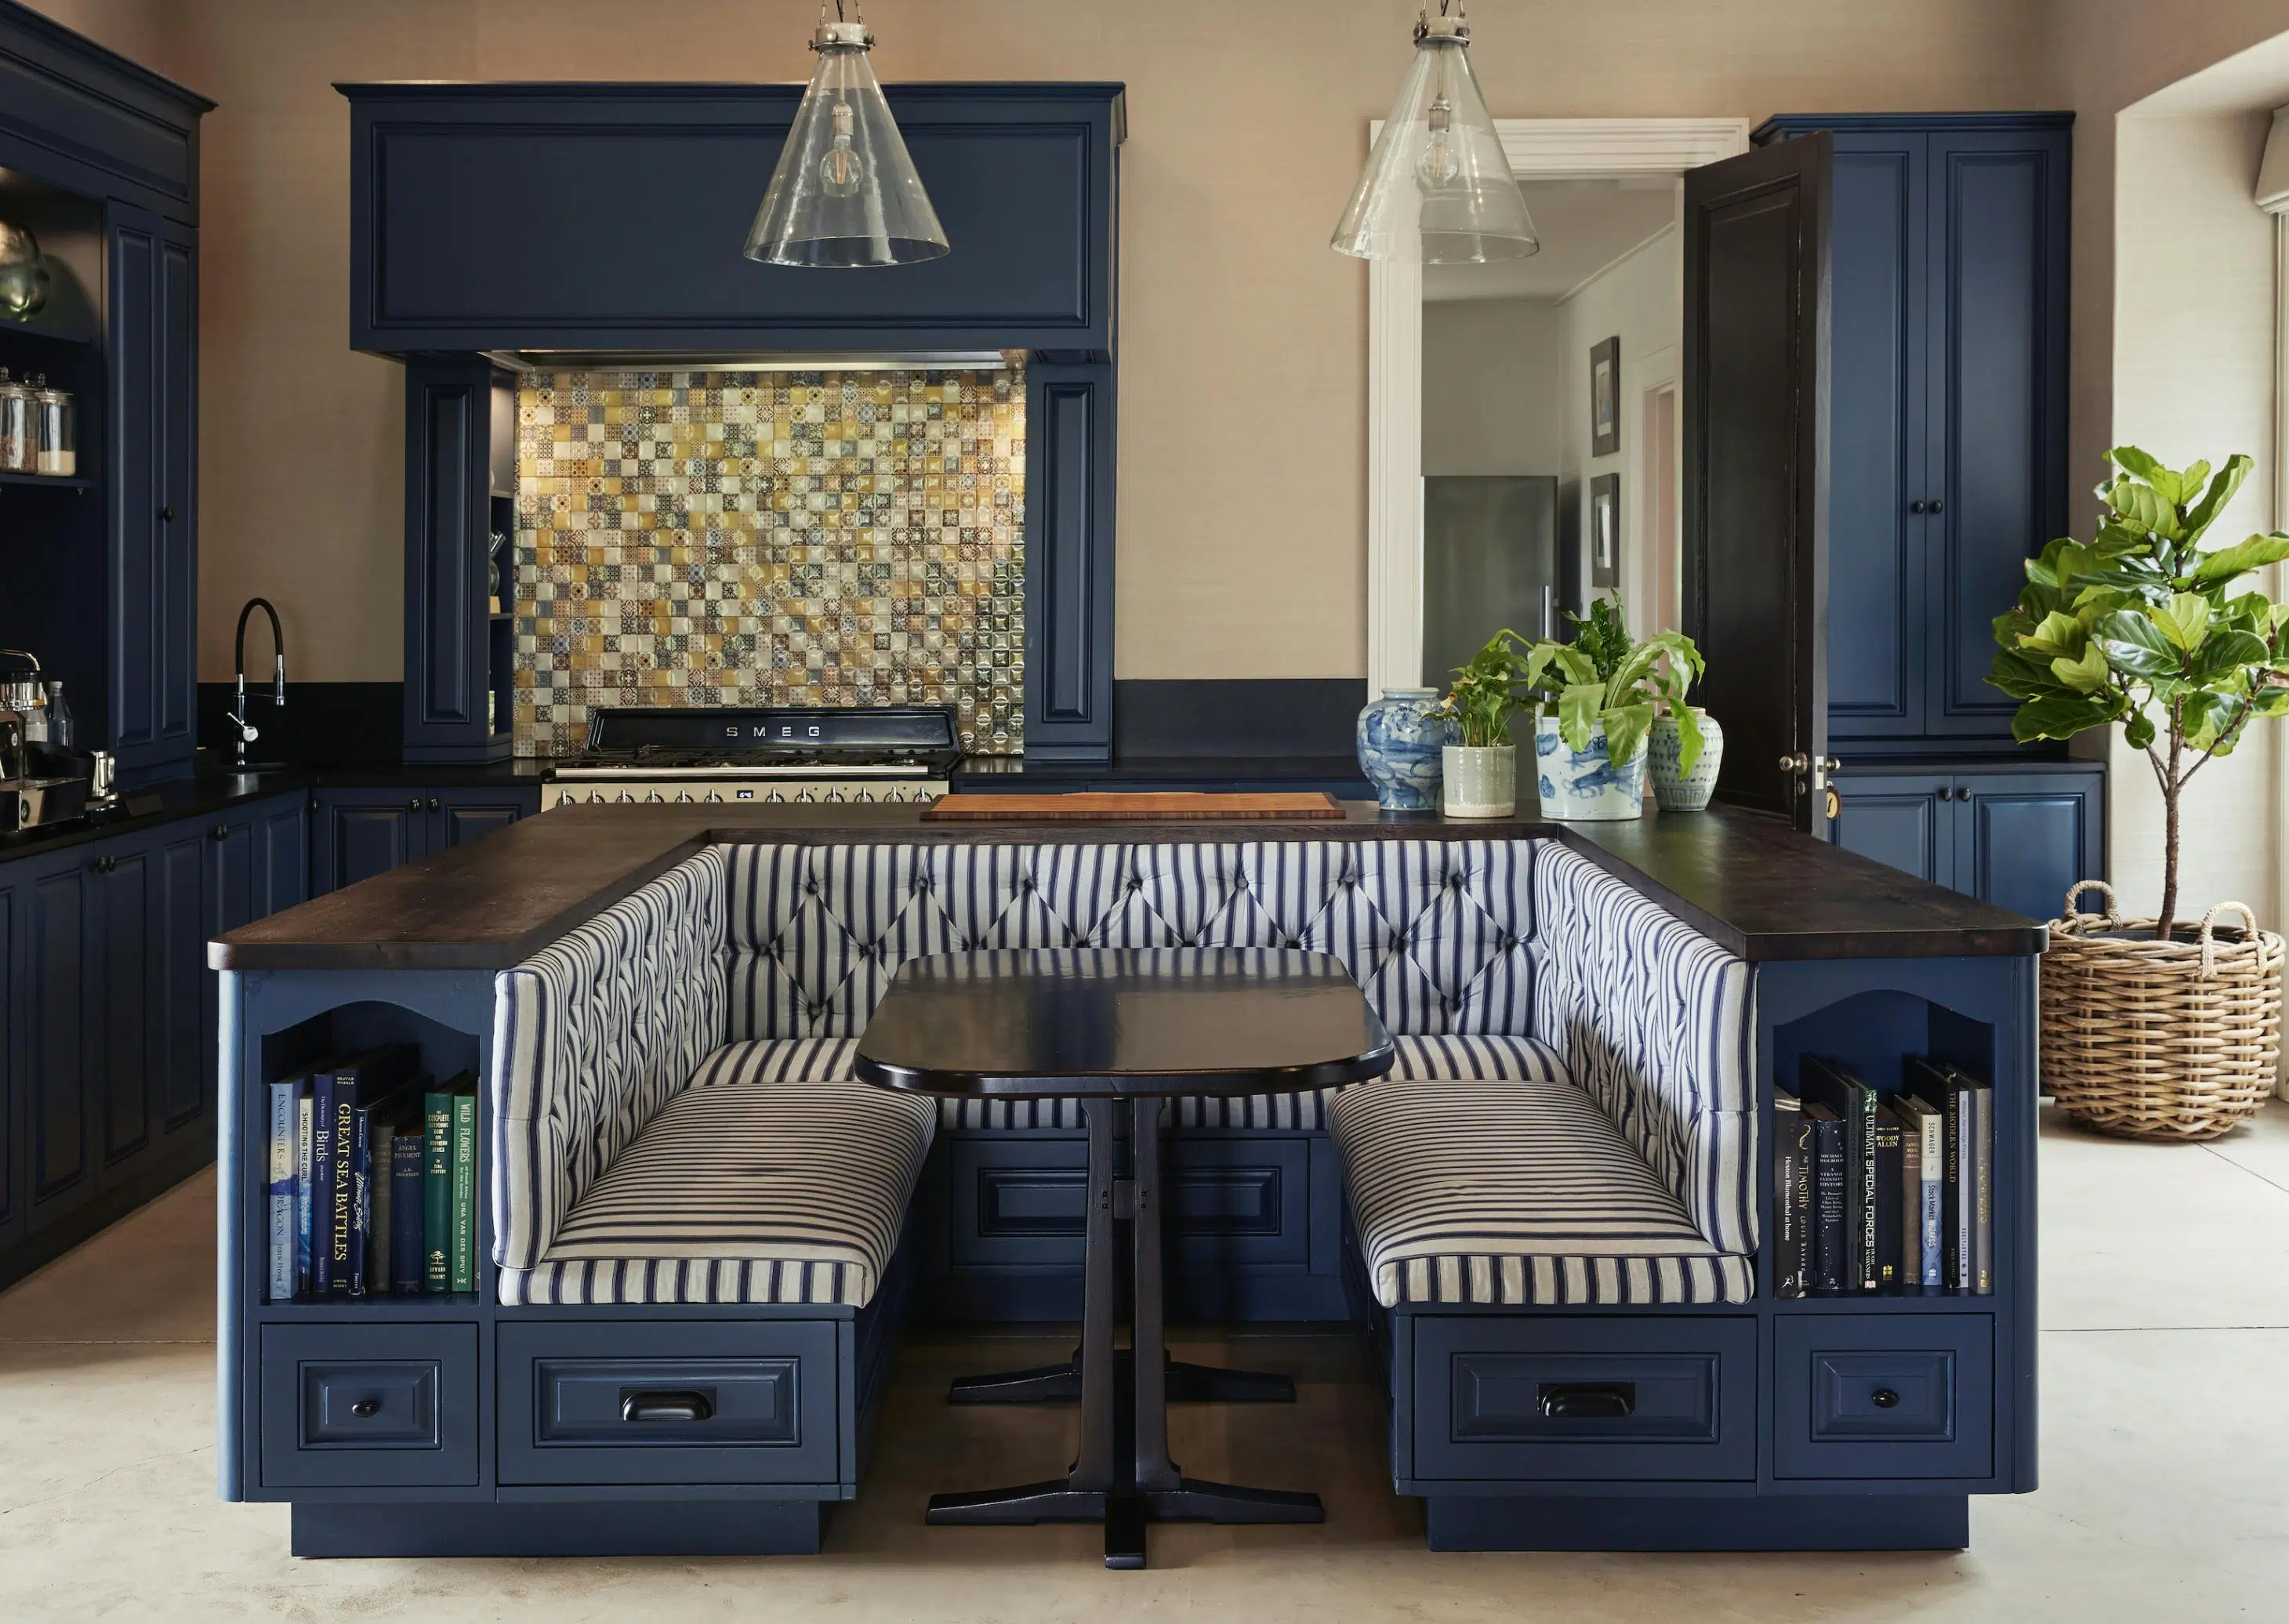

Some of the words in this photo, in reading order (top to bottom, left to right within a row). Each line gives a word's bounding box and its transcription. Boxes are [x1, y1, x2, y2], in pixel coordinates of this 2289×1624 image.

[726, 726, 820, 737] SMEG
[277, 1093, 286, 1159] ENCOUNTERS
[337, 1103, 351, 1157] GREAT
[460, 1104, 471, 1123] WILD
[316, 1130, 330, 1162] Birds
[459, 1128, 470, 1163] FLOWERS
[1866, 1115, 1874, 1156] ULTIMATE
[336, 1160, 349, 1190] SEA
[1798, 1165, 1810, 1209] TIMOTHY
[1866, 1160, 1874, 1203] SPECIAL
[1928, 1184, 1936, 1200] Stock
[334, 1192, 348, 1260] BATTLES
[1866, 1205, 1874, 1247] FORCES
[1928, 1201, 1936, 1220] Market
